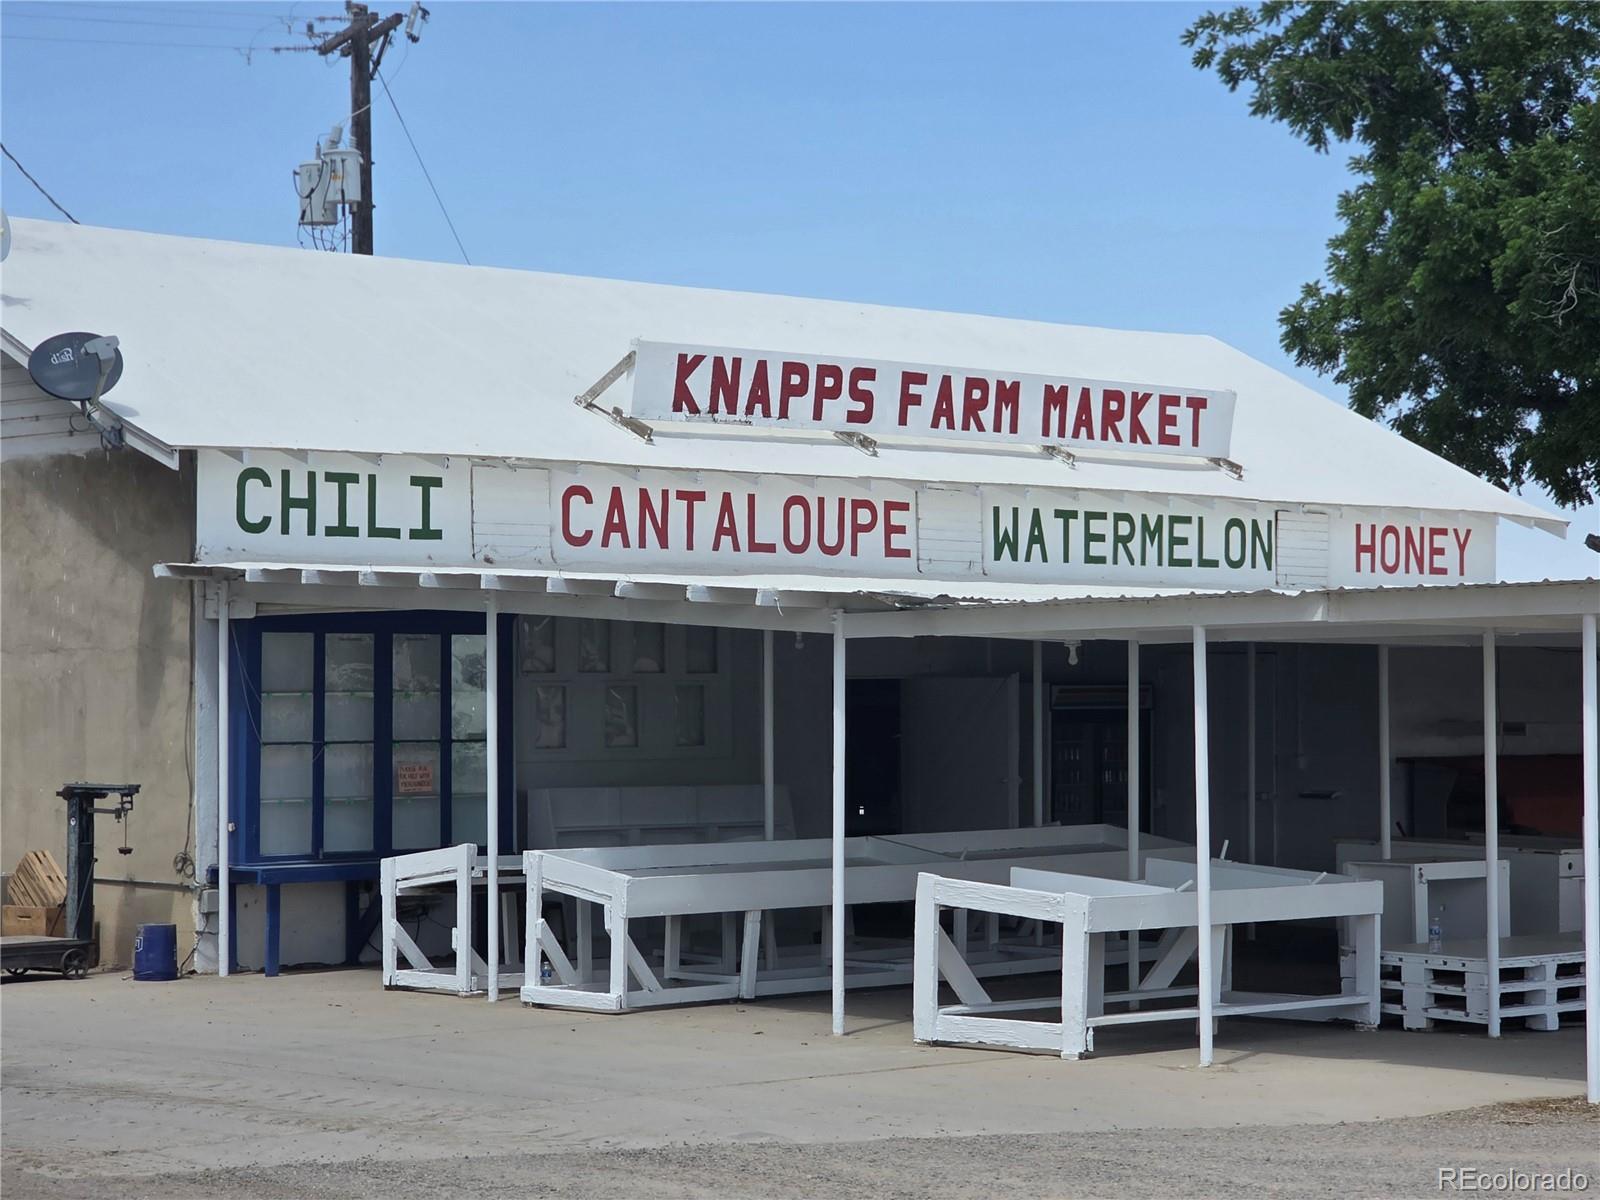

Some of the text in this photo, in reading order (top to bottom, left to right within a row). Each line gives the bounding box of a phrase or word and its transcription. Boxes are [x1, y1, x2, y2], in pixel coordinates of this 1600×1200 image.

[51, 348, 74, 364] dish
[672, 353, 1208, 448] KNAPPS FARM MARKET
[237, 468, 443, 541] CHILI
[561, 484, 912, 558] CANTALOUPE
[992, 505, 1274, 571] WATERMELON
[1355, 523, 1473, 577] HONEY
